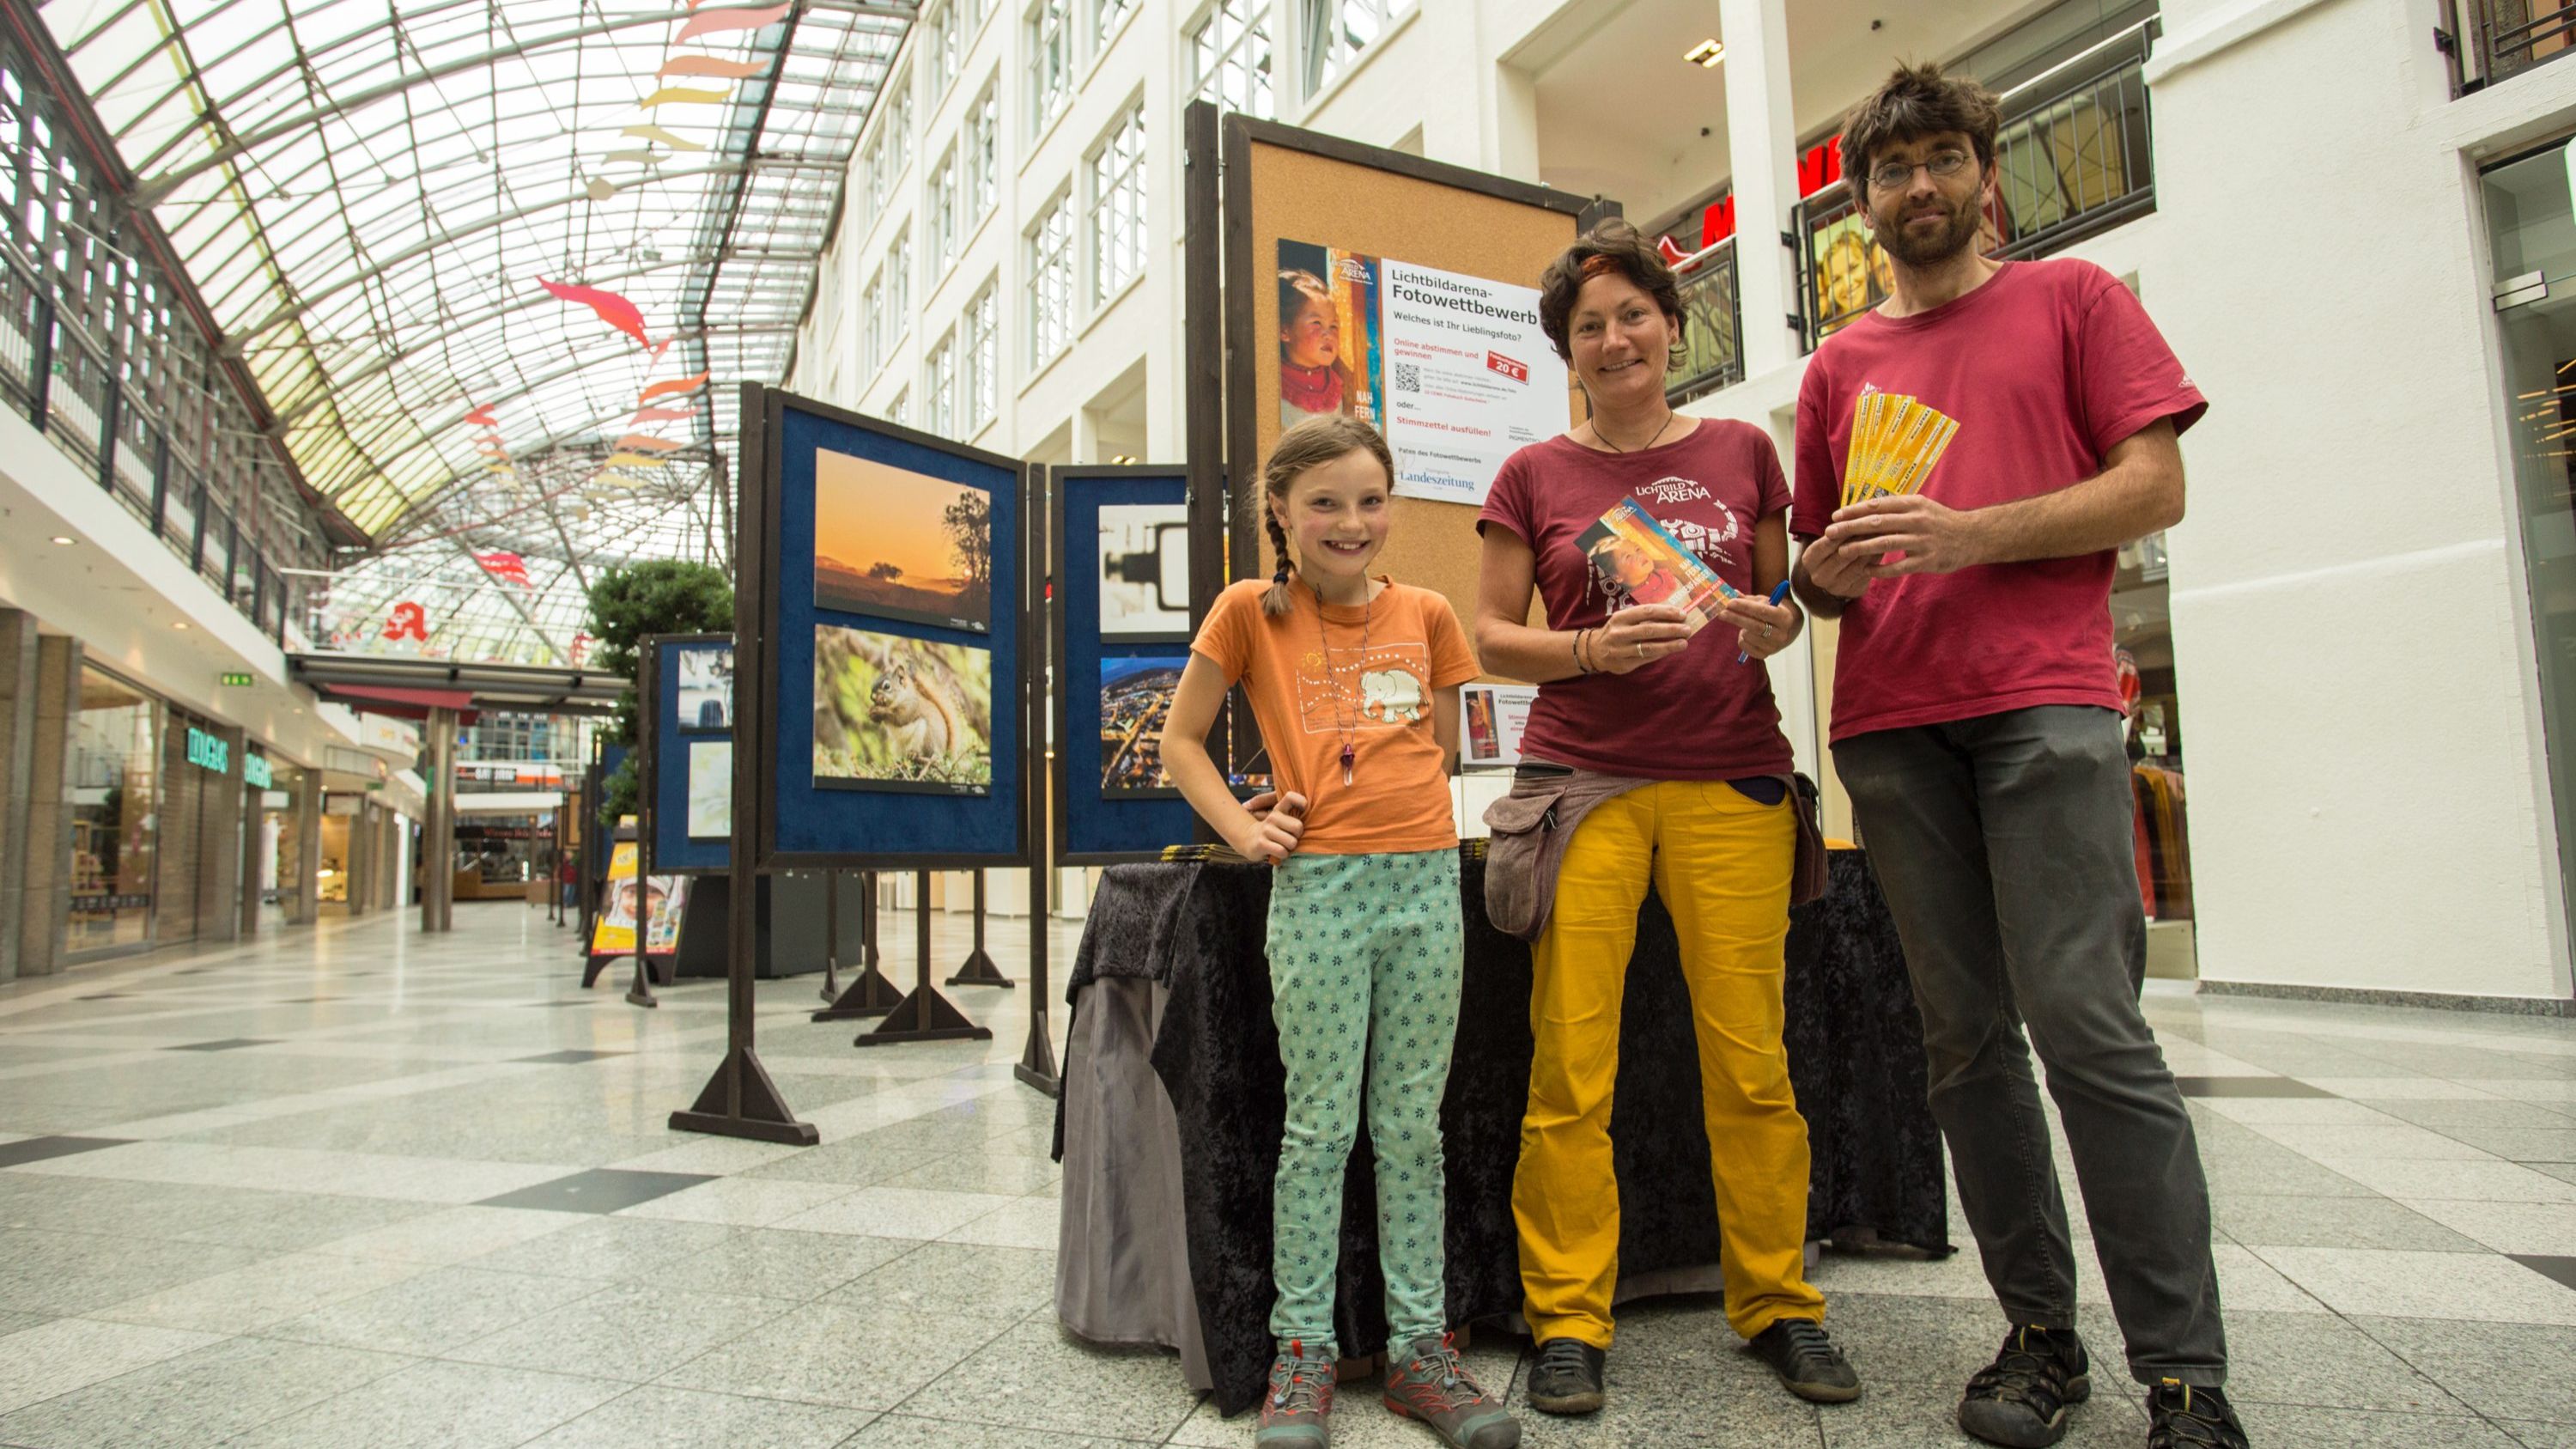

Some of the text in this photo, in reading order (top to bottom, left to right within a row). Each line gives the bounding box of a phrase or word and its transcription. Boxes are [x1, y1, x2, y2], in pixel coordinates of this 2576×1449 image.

[1392, 269, 1492, 298] Lichtbildarena-
[1393, 284, 1538, 325] Fotowettbewerb
[1394, 311, 1522, 342] Welches ist Ihr Lieblingsfoto?
[1394, 338, 1479, 359] Online abstimmen und
[1394, 348, 1432, 361] gewinnen
[1496, 361, 1510, 374] 20
[1511, 367, 1519, 377] €
[1356, 390, 1373, 405] NAH
[1354, 405, 1376, 420] FERN
[1396, 417, 1492, 437] Stimmzettel ausfüllen!
[1429, 451, 1482, 464] Fotowettbewerbs
[1400, 471, 1475, 491] Landeszeitung
[1635, 482, 1686, 496] LICHTBILD
[1656, 486, 1711, 504] ARENA
